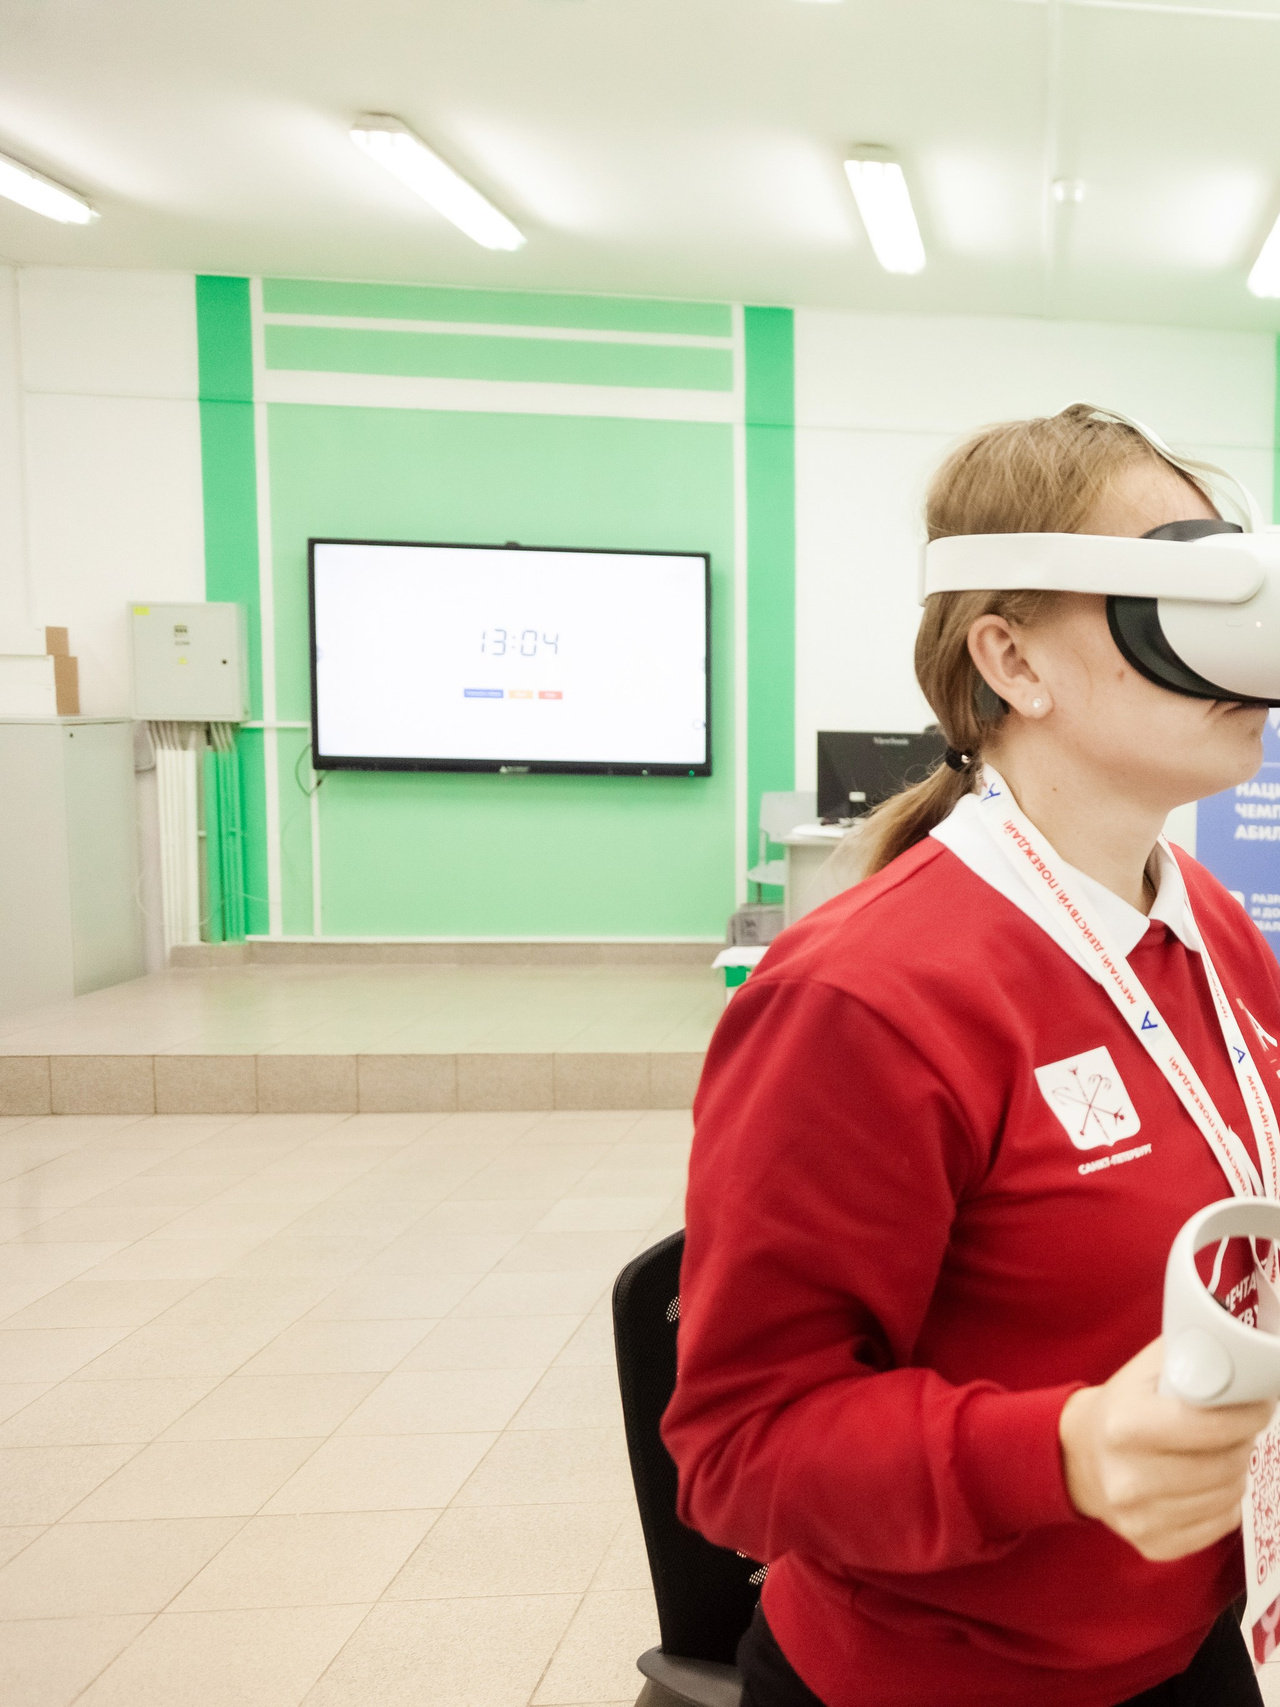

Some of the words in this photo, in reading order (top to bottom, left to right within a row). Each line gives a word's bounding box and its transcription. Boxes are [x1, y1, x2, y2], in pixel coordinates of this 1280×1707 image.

[481, 628, 559, 656] 13:04
[1003, 819, 1059, 890] ПОБЕЖДАЙ!
[1056, 888, 1105, 953] ДЕЙСТВУЙ!
[1251, 907, 1261, 916] И
[1101, 952, 1136, 1004] МЕЧТАЙ!
[1169, 1056, 1216, 1128] ПОБЕЖДАЙ!
[1246, 1075, 1270, 1128] МЕЧТАЙ!
